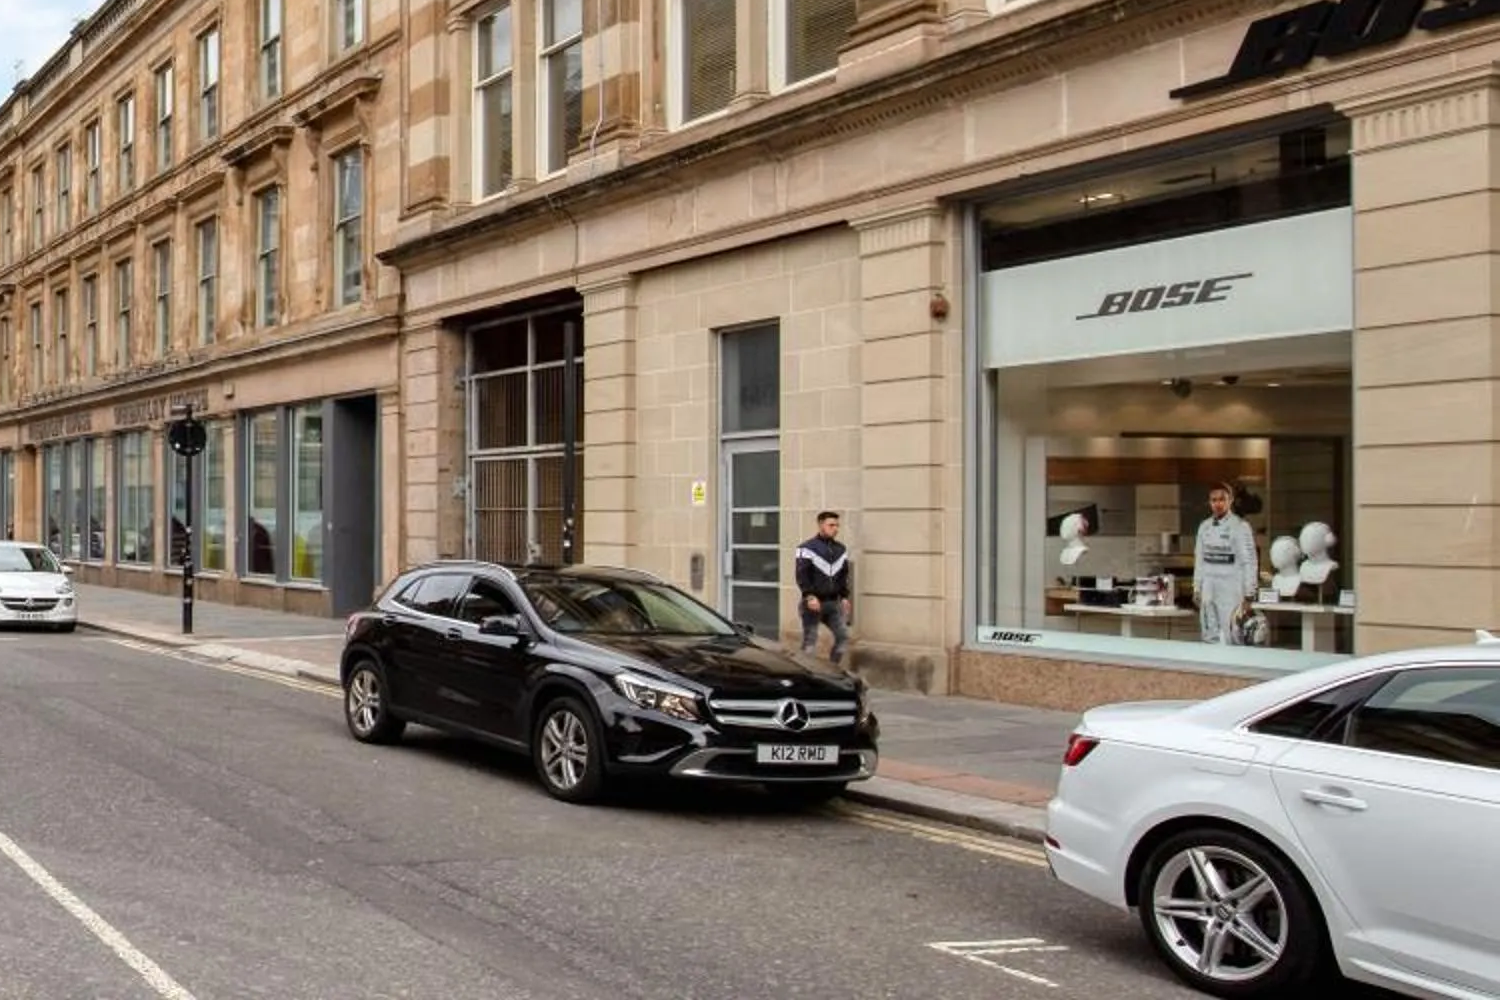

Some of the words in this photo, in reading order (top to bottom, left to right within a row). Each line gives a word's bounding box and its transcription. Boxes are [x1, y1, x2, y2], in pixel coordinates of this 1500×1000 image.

[1076, 272, 1254, 321] BOSE
[990, 631, 1042, 643] BOSE
[771, 747, 795, 761] K12
